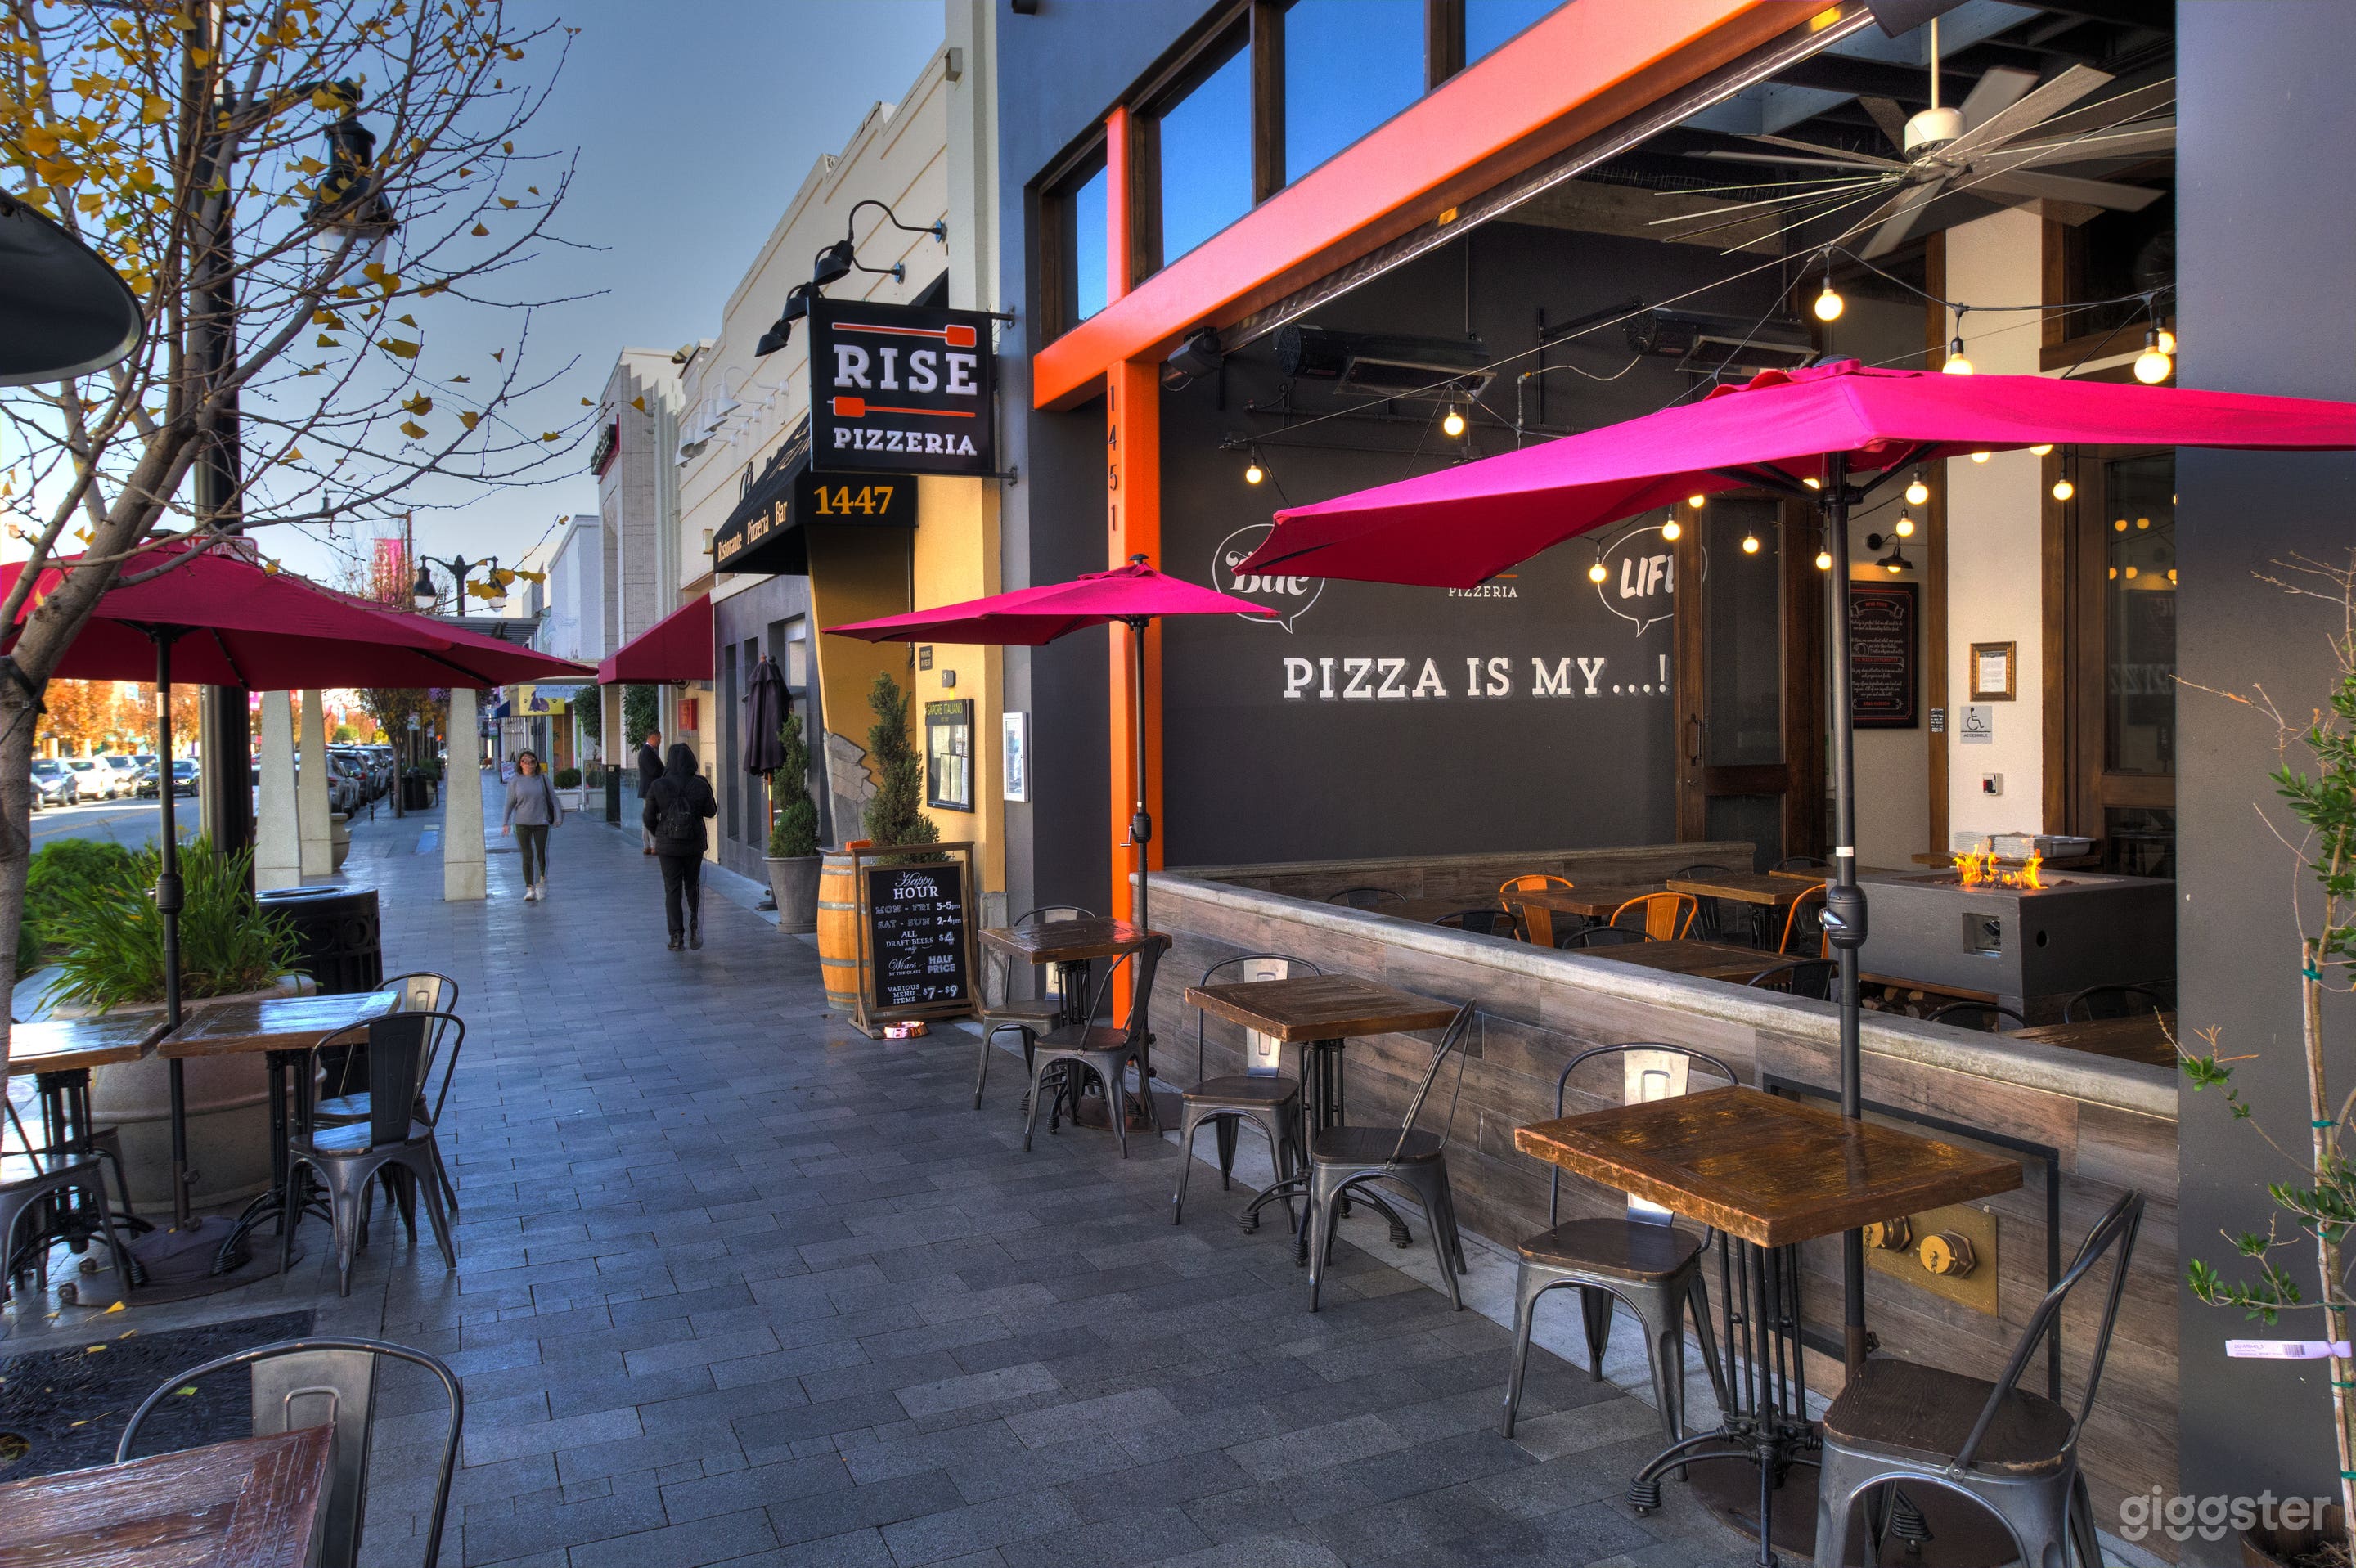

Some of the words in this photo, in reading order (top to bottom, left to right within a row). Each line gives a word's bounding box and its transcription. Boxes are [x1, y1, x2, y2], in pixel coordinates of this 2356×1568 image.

[834, 344, 978, 396] RISE
[834, 427, 978, 456] PIZZERIA
[1107, 384, 1118, 532] 1451
[814, 486, 894, 514] 1447
[718, 531, 742, 563] Ristorante
[747, 509, 769, 545] Pizzeria
[776, 501, 788, 527] Bar
[1448, 586, 1518, 598] PIZZERIA
[1283, 657, 1448, 700] PIZZA
[1467, 657, 1512, 698] IS
[927, 703, 942, 716] SAPORE
[943, 702, 963, 714] ITALIANO
[895, 871, 935, 889] Happy
[893, 886, 939, 900] HOUR
[875, 905, 901, 914] MON
[912, 903, 931, 911] FRI
[877, 919, 897, 929] SAT
[907, 917, 930, 927] SUN
[901, 930, 917, 938] ALL
[938, 931, 955, 946] $4
[886, 939, 910, 947] DRAFT
[888, 956, 916, 971] Wines
[928, 955, 953, 964] HALF
[927, 964, 955, 973] PRICE
[888, 984, 920, 992] VARIOUS
[923, 986, 936, 1000] $7
[945, 984, 958, 997] $9
[893, 996, 915, 1004] ITEMS
